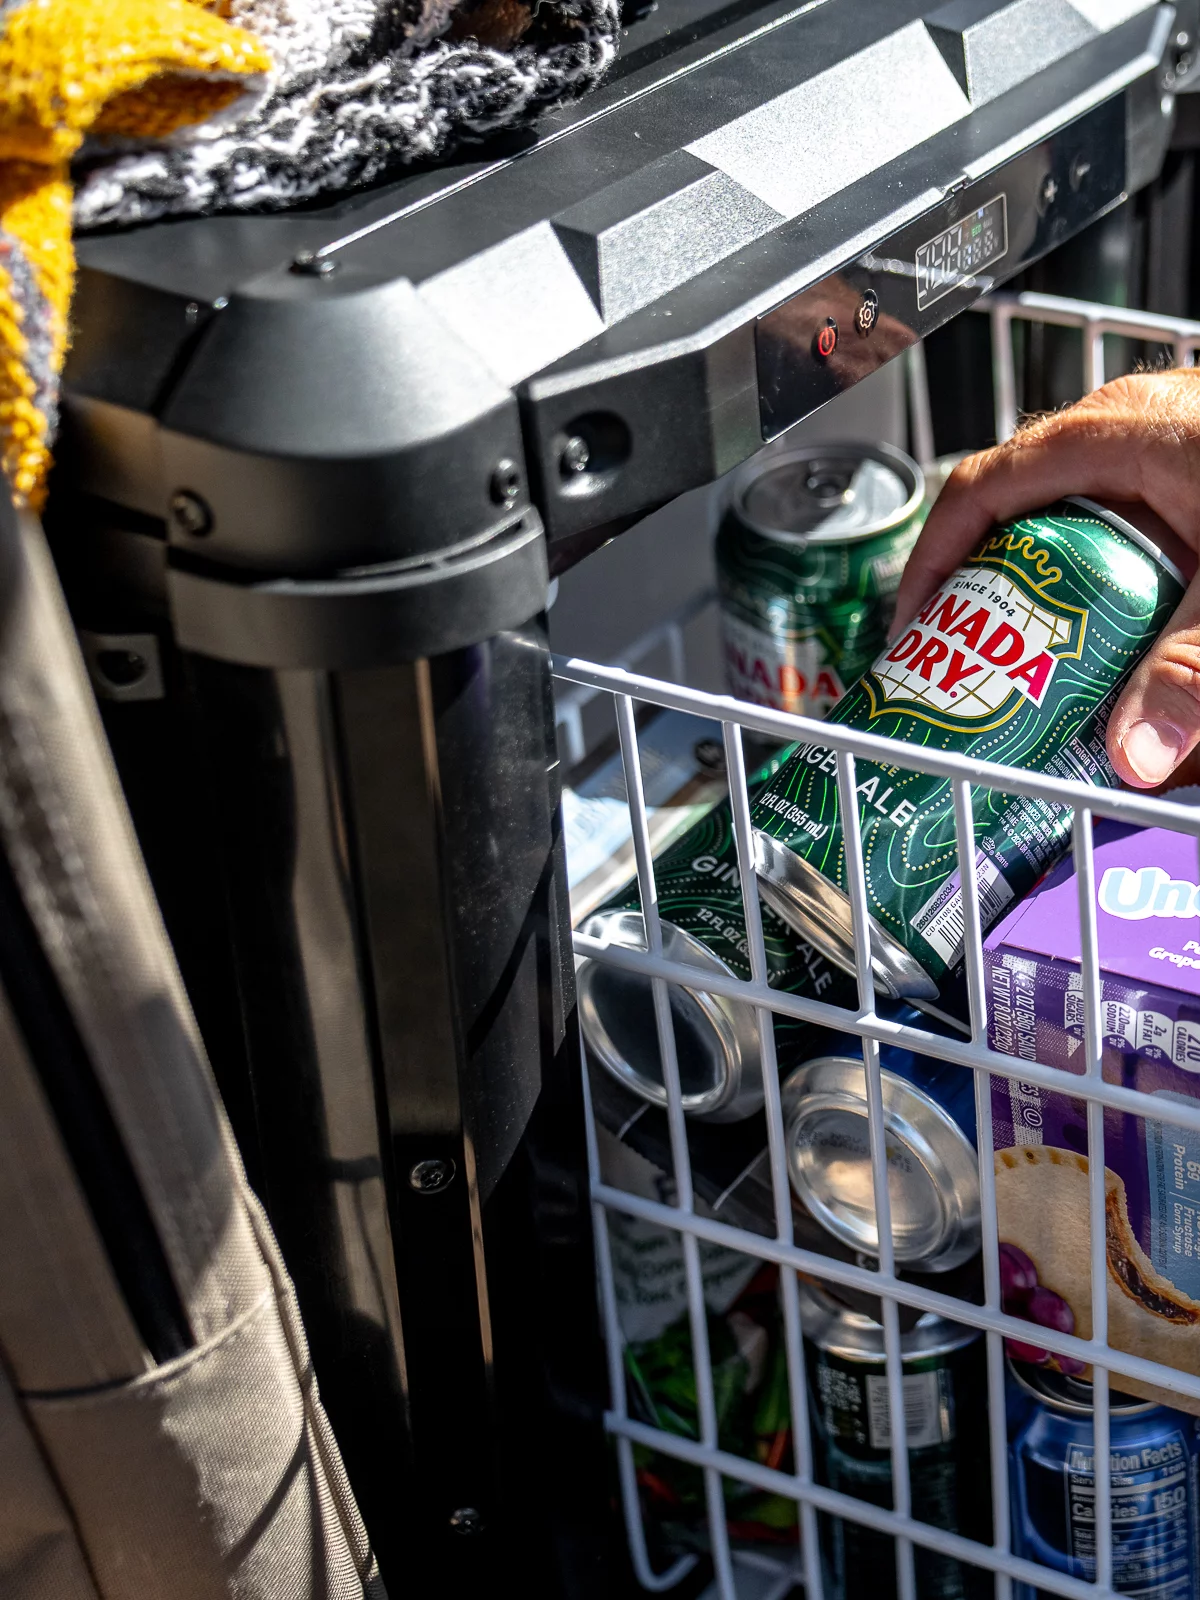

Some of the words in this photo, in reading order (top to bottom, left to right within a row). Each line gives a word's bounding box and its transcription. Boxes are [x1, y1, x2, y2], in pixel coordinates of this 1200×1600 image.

[953, 581, 987, 594] SINCE
[988, 591, 1016, 618] 1904
[915, 592, 1054, 701] ANADA
[1051, 754, 1075, 781] CARBONAT
[1069, 738, 1091, 768] Protein
[1089, 763, 1097, 776] 0g
[759, 792, 769, 805] 12
[764, 794, 777, 809] FL
[774, 799, 790, 815] OZ
[785, 804, 805, 824] (355
[803, 819, 828, 841] mL)
[855, 776, 917, 828] ALE
[1010, 801, 1020, 813] DR
[1016, 793, 1041, 822] PRODUCED
[1003, 809, 1020, 827] FAME
[696, 907, 710, 922] 12
[709, 916, 725, 932] FL
[722, 927, 742, 944] OZ
[796, 942, 833, 996] ALE
[992, 966, 1009, 988] NET
[993, 986, 1011, 1007] WT
[993, 1004, 1011, 1013] 8
[1016, 995, 1034, 1010] OZ
[1066, 993, 1077, 1023] SUGARS
[1076, 997, 1085, 1024] ADDED
[994, 1012, 1012, 1028] OZ
[1015, 1008, 1036, 1035] (58g)
[1106, 1002, 1117, 1033] SODIUM
[1117, 1006, 1131, 1036] 220mg
[1143, 1012, 1154, 1028] SAT
[1153, 1025, 1167, 1038] 2g
[992, 1023, 1014, 1055] (232g)
[1142, 1027, 1153, 1044] FAT
[1176, 1026, 1187, 1063] CALORIES
[1173, 1143, 1188, 1190] Protein
[1174, 1202, 1184, 1224] Corn
[1172, 1224, 1184, 1254] Syrup
[1184, 1205, 1195, 1257] Fructose
[1071, 1450, 1141, 1471] Nution
[1141, 1442, 1183, 1467] Facts
[1071, 1474, 1095, 1486] Serv
[1072, 1502, 1139, 1517] Caries
[1153, 1485, 1186, 1511] 150
